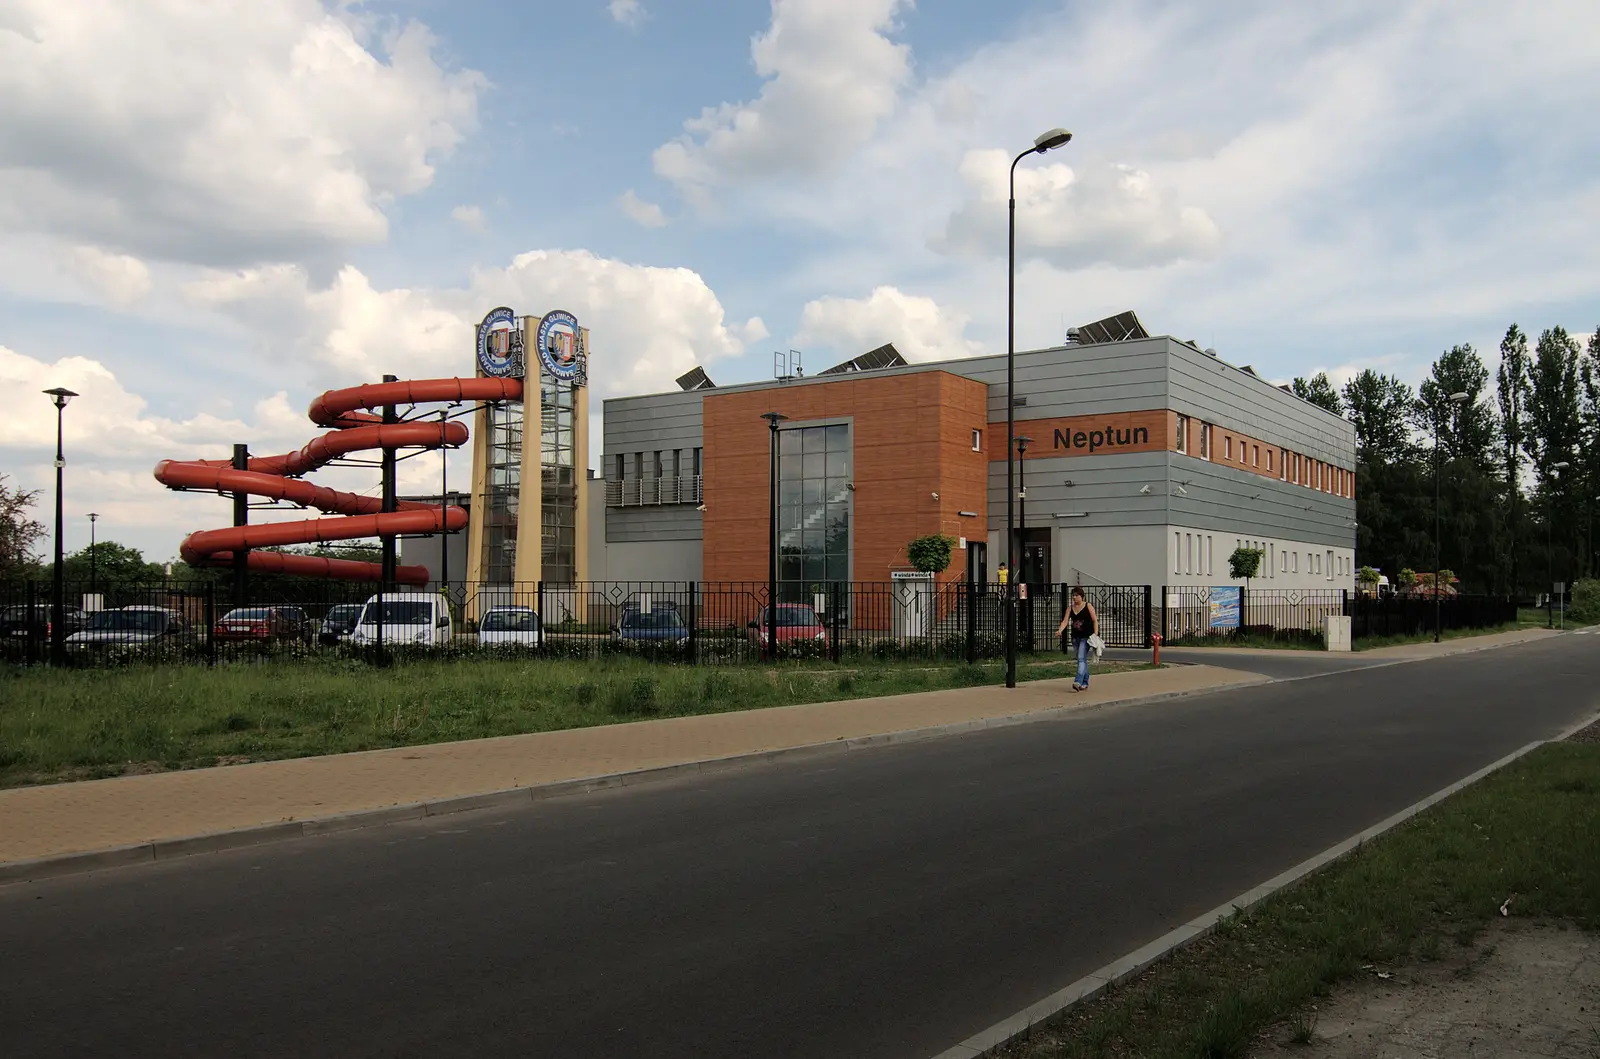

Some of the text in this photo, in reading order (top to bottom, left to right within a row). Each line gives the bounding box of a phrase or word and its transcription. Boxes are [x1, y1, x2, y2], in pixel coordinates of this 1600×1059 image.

[478, 324, 488, 354] MIASTA
[486, 310, 511, 324] GLIWICE
[539, 320, 550, 350] MIASTA
[548, 313, 576, 326] GLIWICE
[1054, 426, 1148, 452] Neptun
